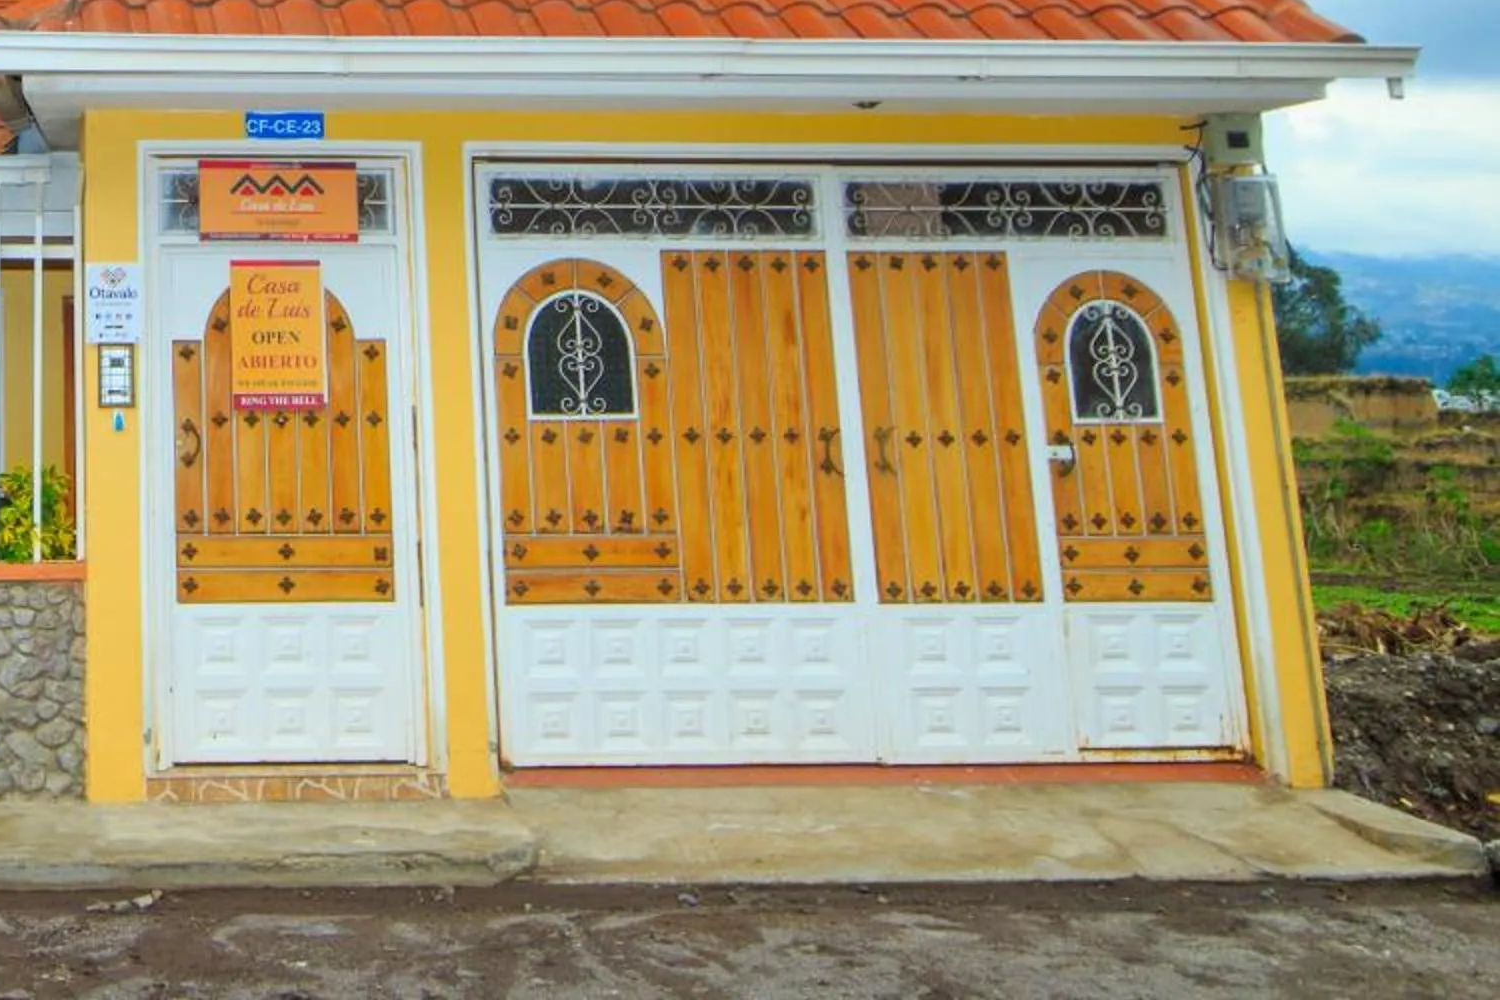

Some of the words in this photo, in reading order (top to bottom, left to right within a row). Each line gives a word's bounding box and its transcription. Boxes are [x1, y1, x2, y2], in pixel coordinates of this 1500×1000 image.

[246, 119, 321, 134] CF-CE-23
[247, 273, 299, 295] Casa
[88, 286, 138, 299] Otavalo
[237, 299, 260, 319] de
[267, 298, 311, 319] Luis
[252, 330, 300, 345] OPEN
[240, 355, 317, 369] ABIERTO
